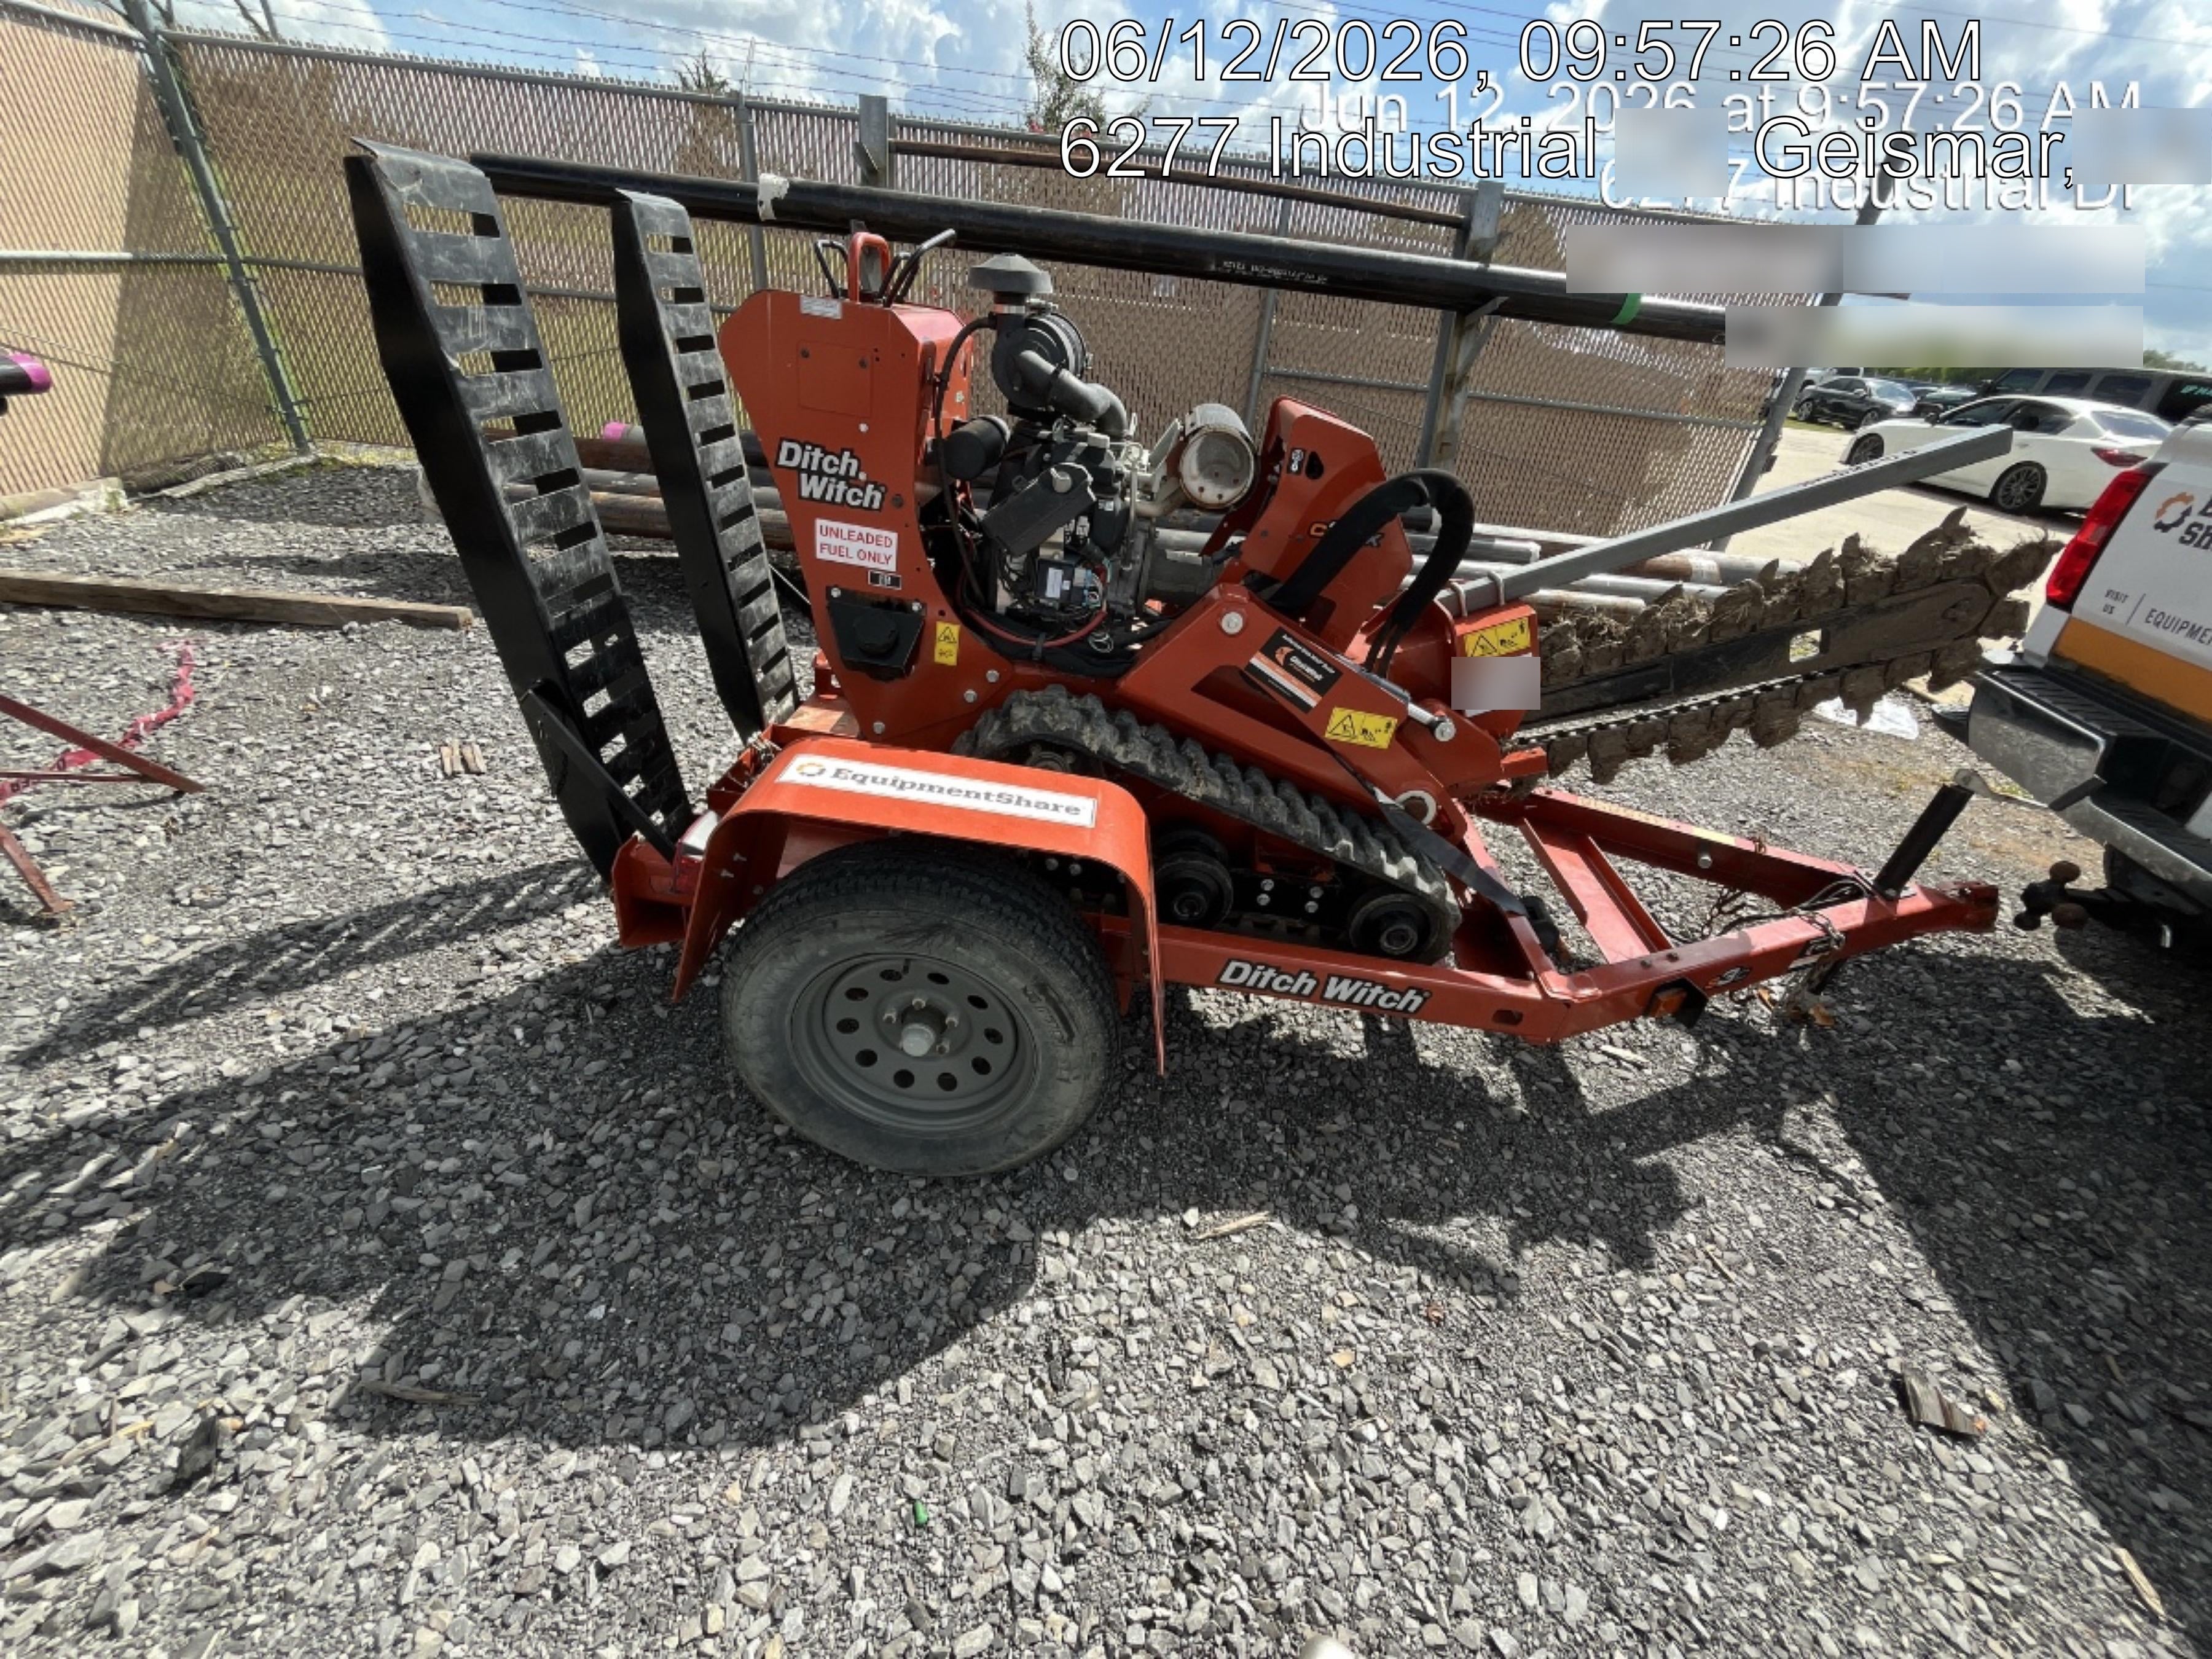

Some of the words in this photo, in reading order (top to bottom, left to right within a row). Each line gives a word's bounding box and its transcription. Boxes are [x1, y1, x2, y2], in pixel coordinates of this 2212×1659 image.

[777, 440, 858, 477] Ditch
[800, 473, 883, 510] Witch
[820, 524, 893, 547] UNLEADED
[820, 543, 853, 559] FUEL
[857, 549, 892, 565] ONLY
[830, 767, 1081, 815] EquipmentShare
[1220, 960, 1317, 995] Ditch
[1323, 975, 1430, 1013] Witch
